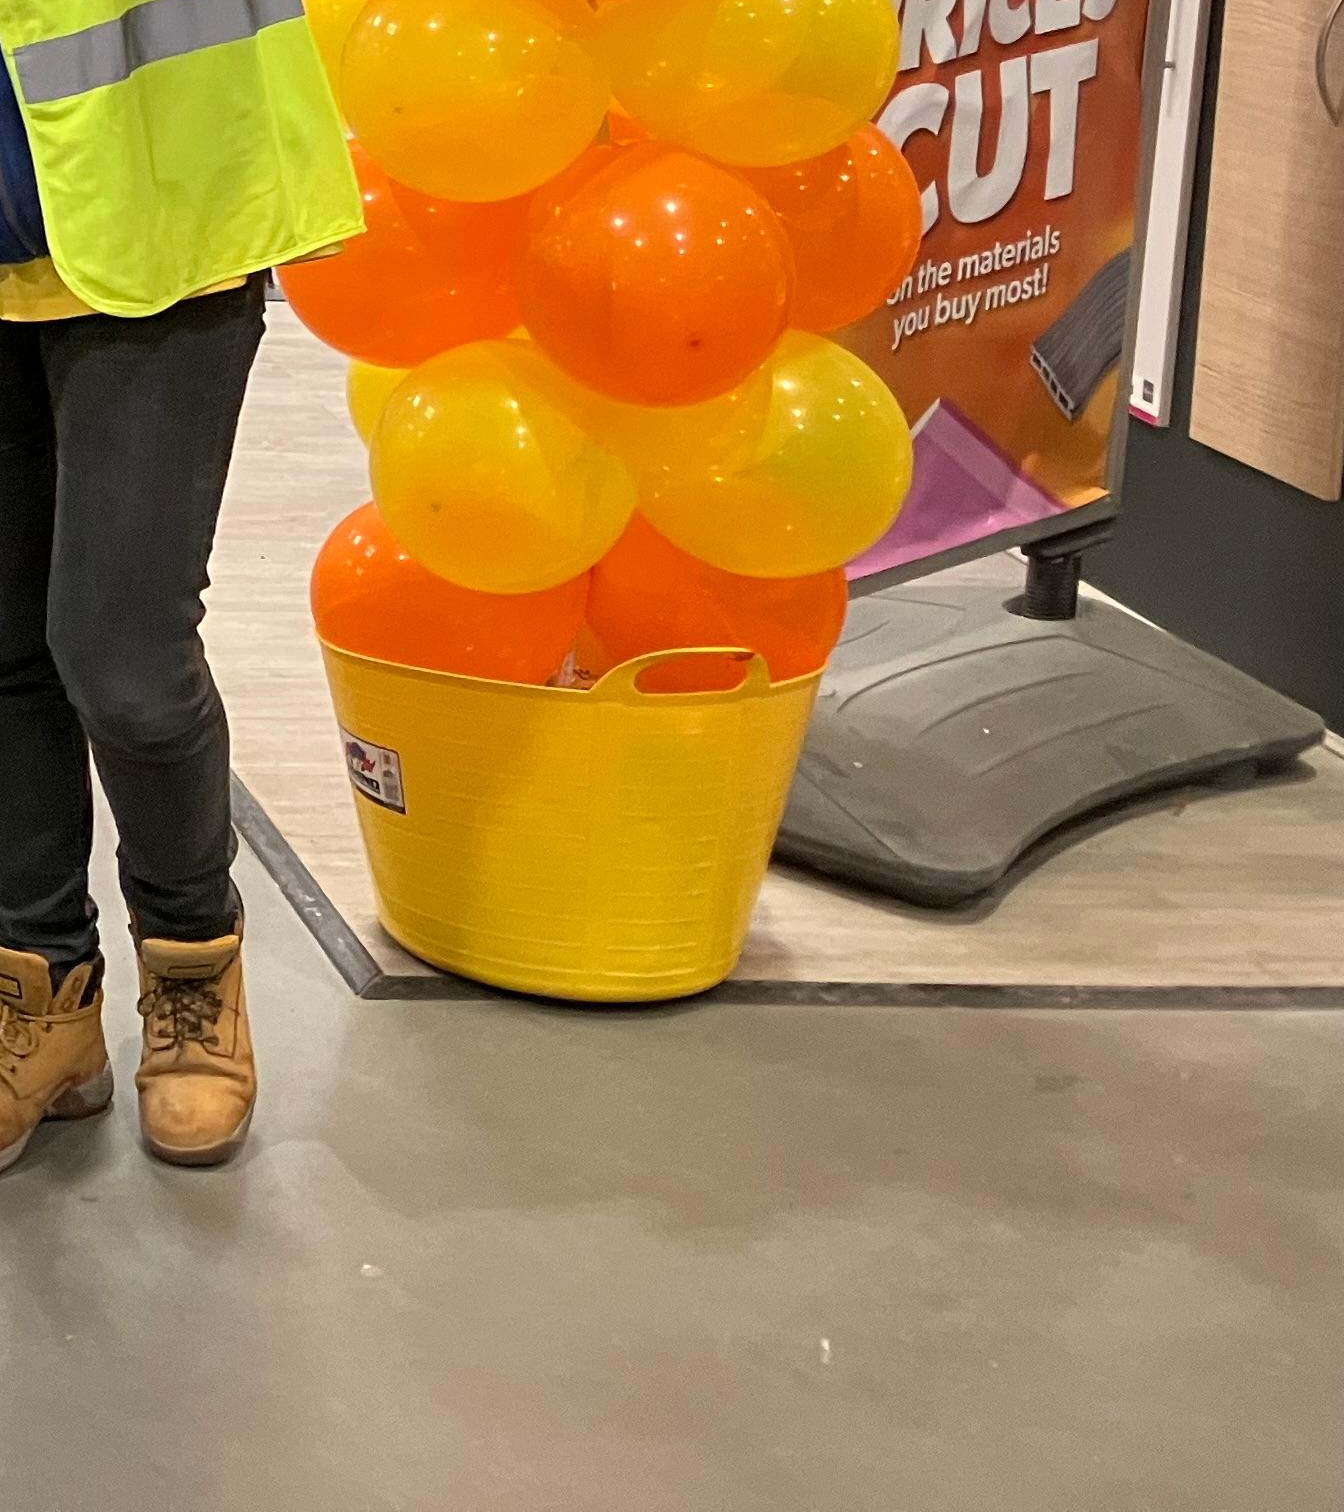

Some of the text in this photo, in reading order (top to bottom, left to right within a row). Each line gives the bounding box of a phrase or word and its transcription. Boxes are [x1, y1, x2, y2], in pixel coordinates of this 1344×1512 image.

[876, 38, 1099, 238] CUT
[918, 259, 952, 294] the
[957, 225, 1061, 281] materials
[892, 263, 1048, 350] you buy most!
